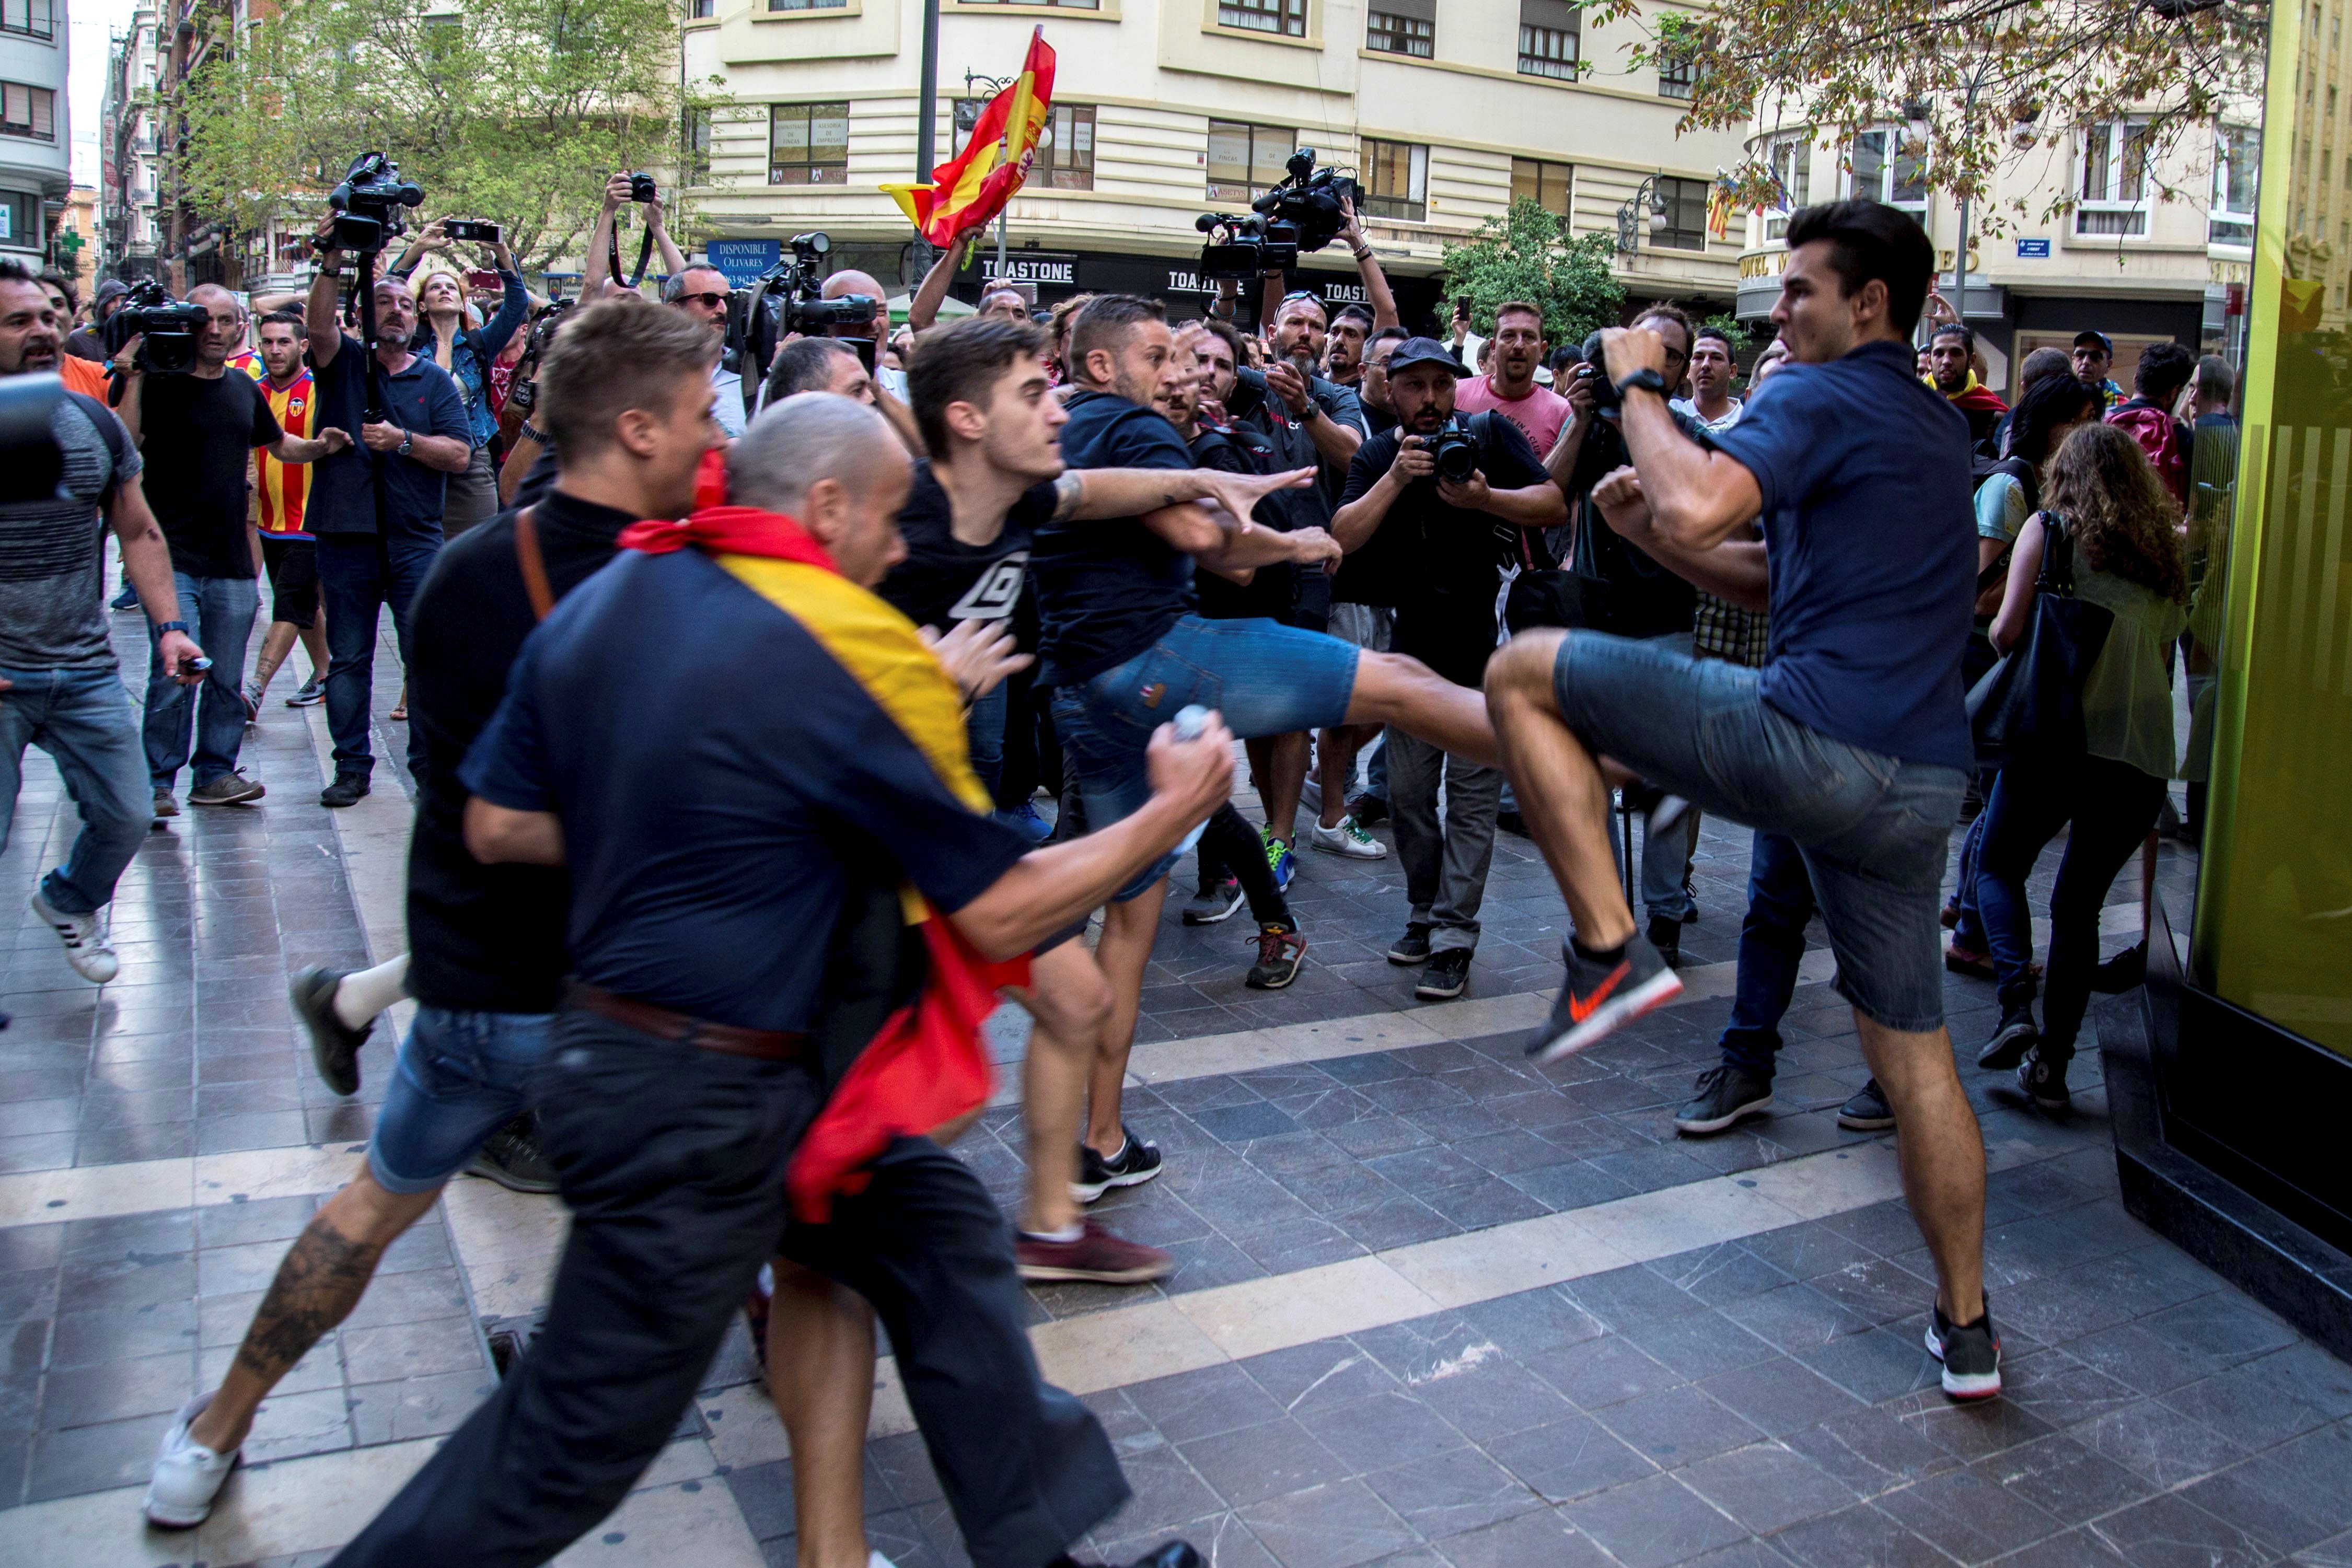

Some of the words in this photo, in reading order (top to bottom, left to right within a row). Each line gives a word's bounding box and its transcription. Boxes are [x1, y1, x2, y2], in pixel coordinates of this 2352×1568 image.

[1218, 188, 1246, 197] ASETYS
[720, 244, 767, 254] DISPONIBLE
[724, 257, 762, 267] OLIVARES
[1739, 255, 1769, 278] HOTEL
[737, 275, 749, 284] 942
[1169, 271, 1244, 292] TOATE
[1516, 421, 1525, 429] IN
[1529, 436, 1541, 456] CLUB
